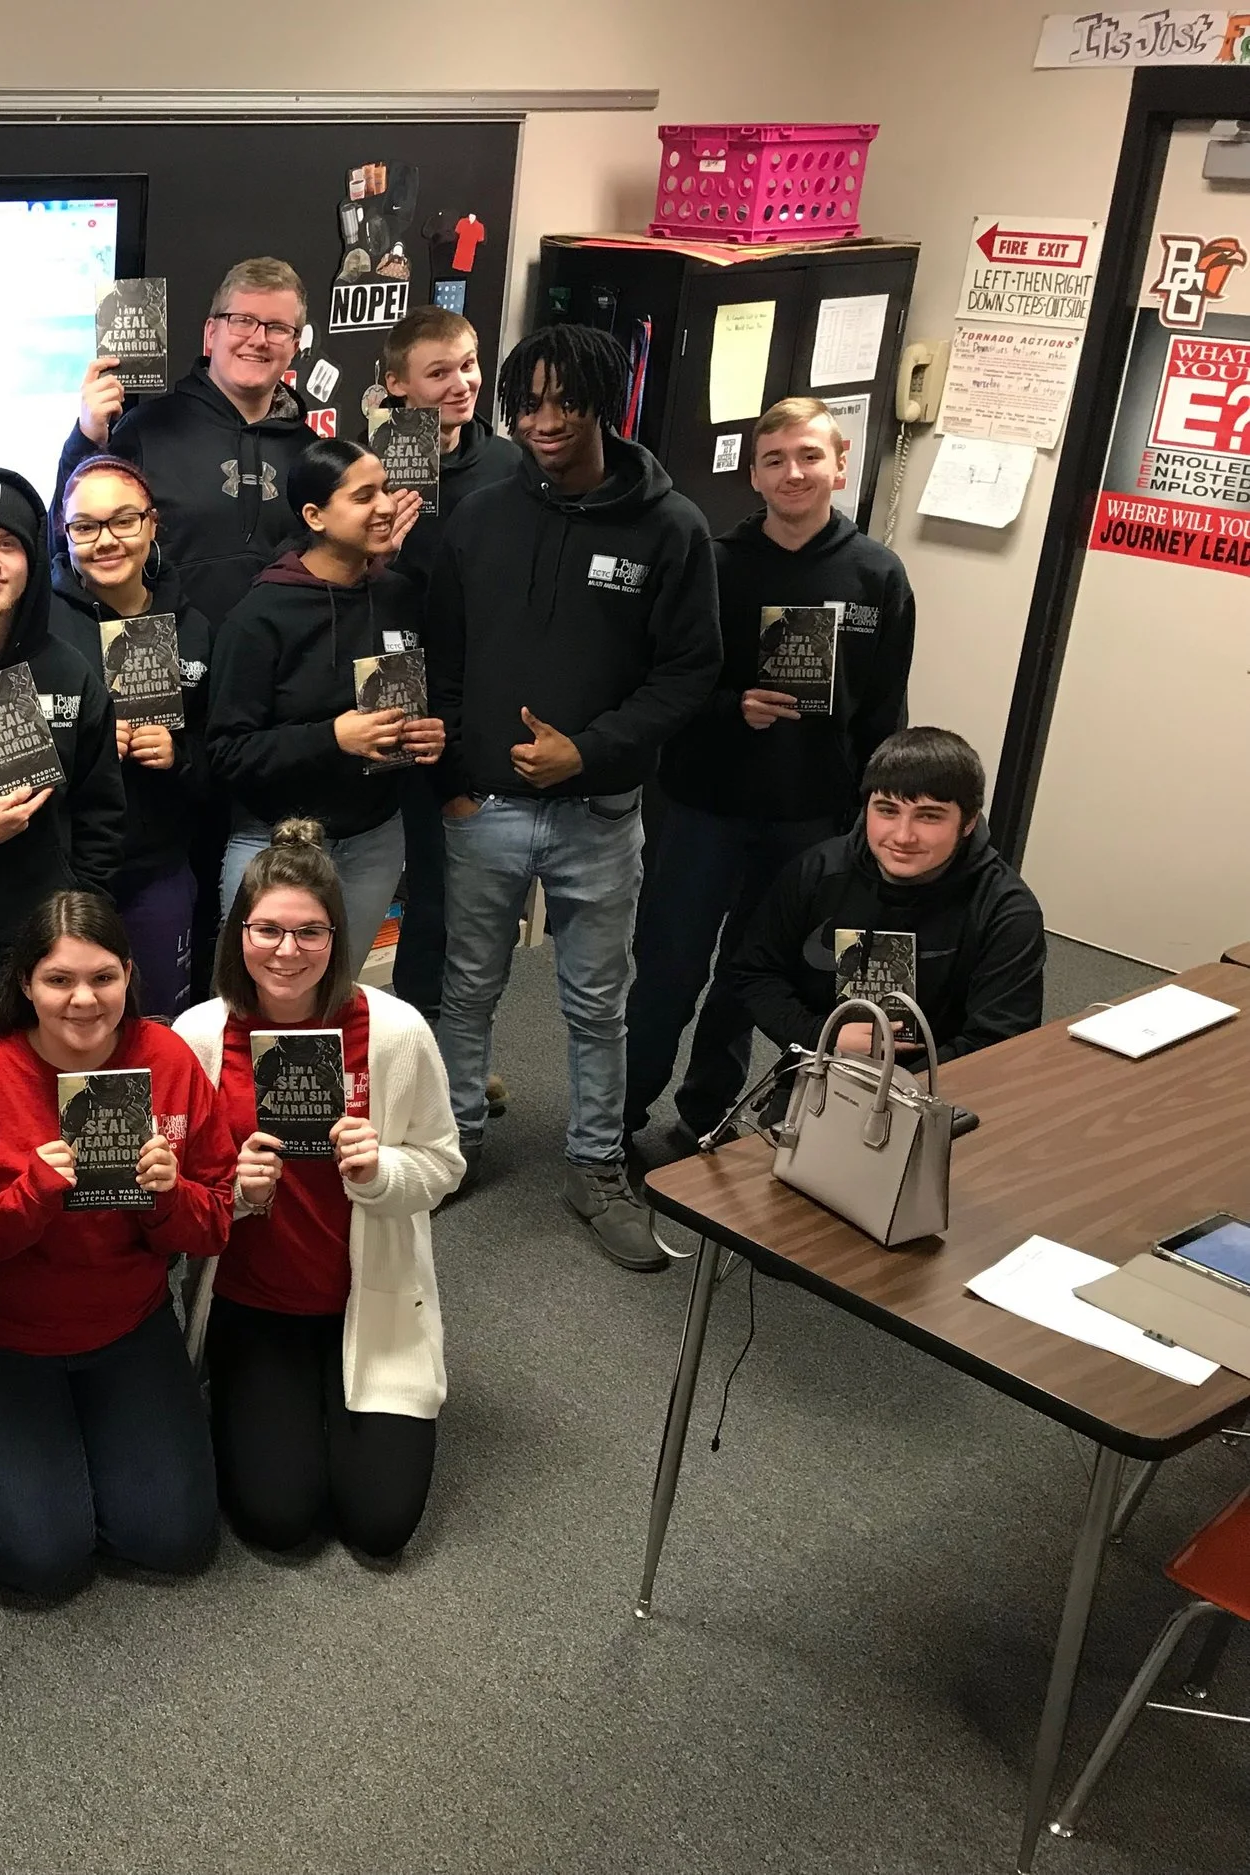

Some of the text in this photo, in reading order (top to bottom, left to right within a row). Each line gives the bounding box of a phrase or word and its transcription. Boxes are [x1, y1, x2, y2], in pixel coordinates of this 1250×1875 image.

[999, 240, 1069, 258] FIRE EXIT
[1055, 273, 1093, 296] RIGHT
[1150, 234, 1206, 326] BG
[332, 281, 407, 325] NOPE!
[968, 291, 1004, 311] DOWN
[114, 316, 148, 329] SEAL
[108, 329, 156, 340] TEAM SIX
[962, 332, 1073, 349] TORNADO ACTIONS
[108, 340, 156, 352] WARRIOR
[387, 444, 422, 457] SEAL
[380, 457, 429, 468] TEAM SIX
[1142, 451, 1250, 476] ENROLLED
[1140, 465, 1250, 489] ENLISTED
[1136, 478, 1250, 503] EMPLOYED
[1107, 500, 1168, 525] WHERE
[1172, 509, 1214, 532] WILL
[1100, 520, 1197, 557] JOURNEY
[592, 569, 610, 578] TCTC
[778, 644, 815, 656] SEAL
[125, 656, 160, 672] SEAL
[770, 657, 822, 666] TEAM SIX
[118, 671, 148, 684] TEAM
[151, 668, 169, 679] SIX
[770, 668, 822, 678] WARRIOR
[120, 680, 170, 696] WARRIOR
[18, 720, 38, 736] SIX
[278, 1076, 321, 1090] SEAL
[268, 1090, 331, 1102] TEAM SIX
[271, 1104, 331, 1115] WARRIOR
[86, 1119, 130, 1135] SEAL
[77, 1134, 140, 1148] TEAM SIX
[78, 1149, 140, 1163] WARRIOR
